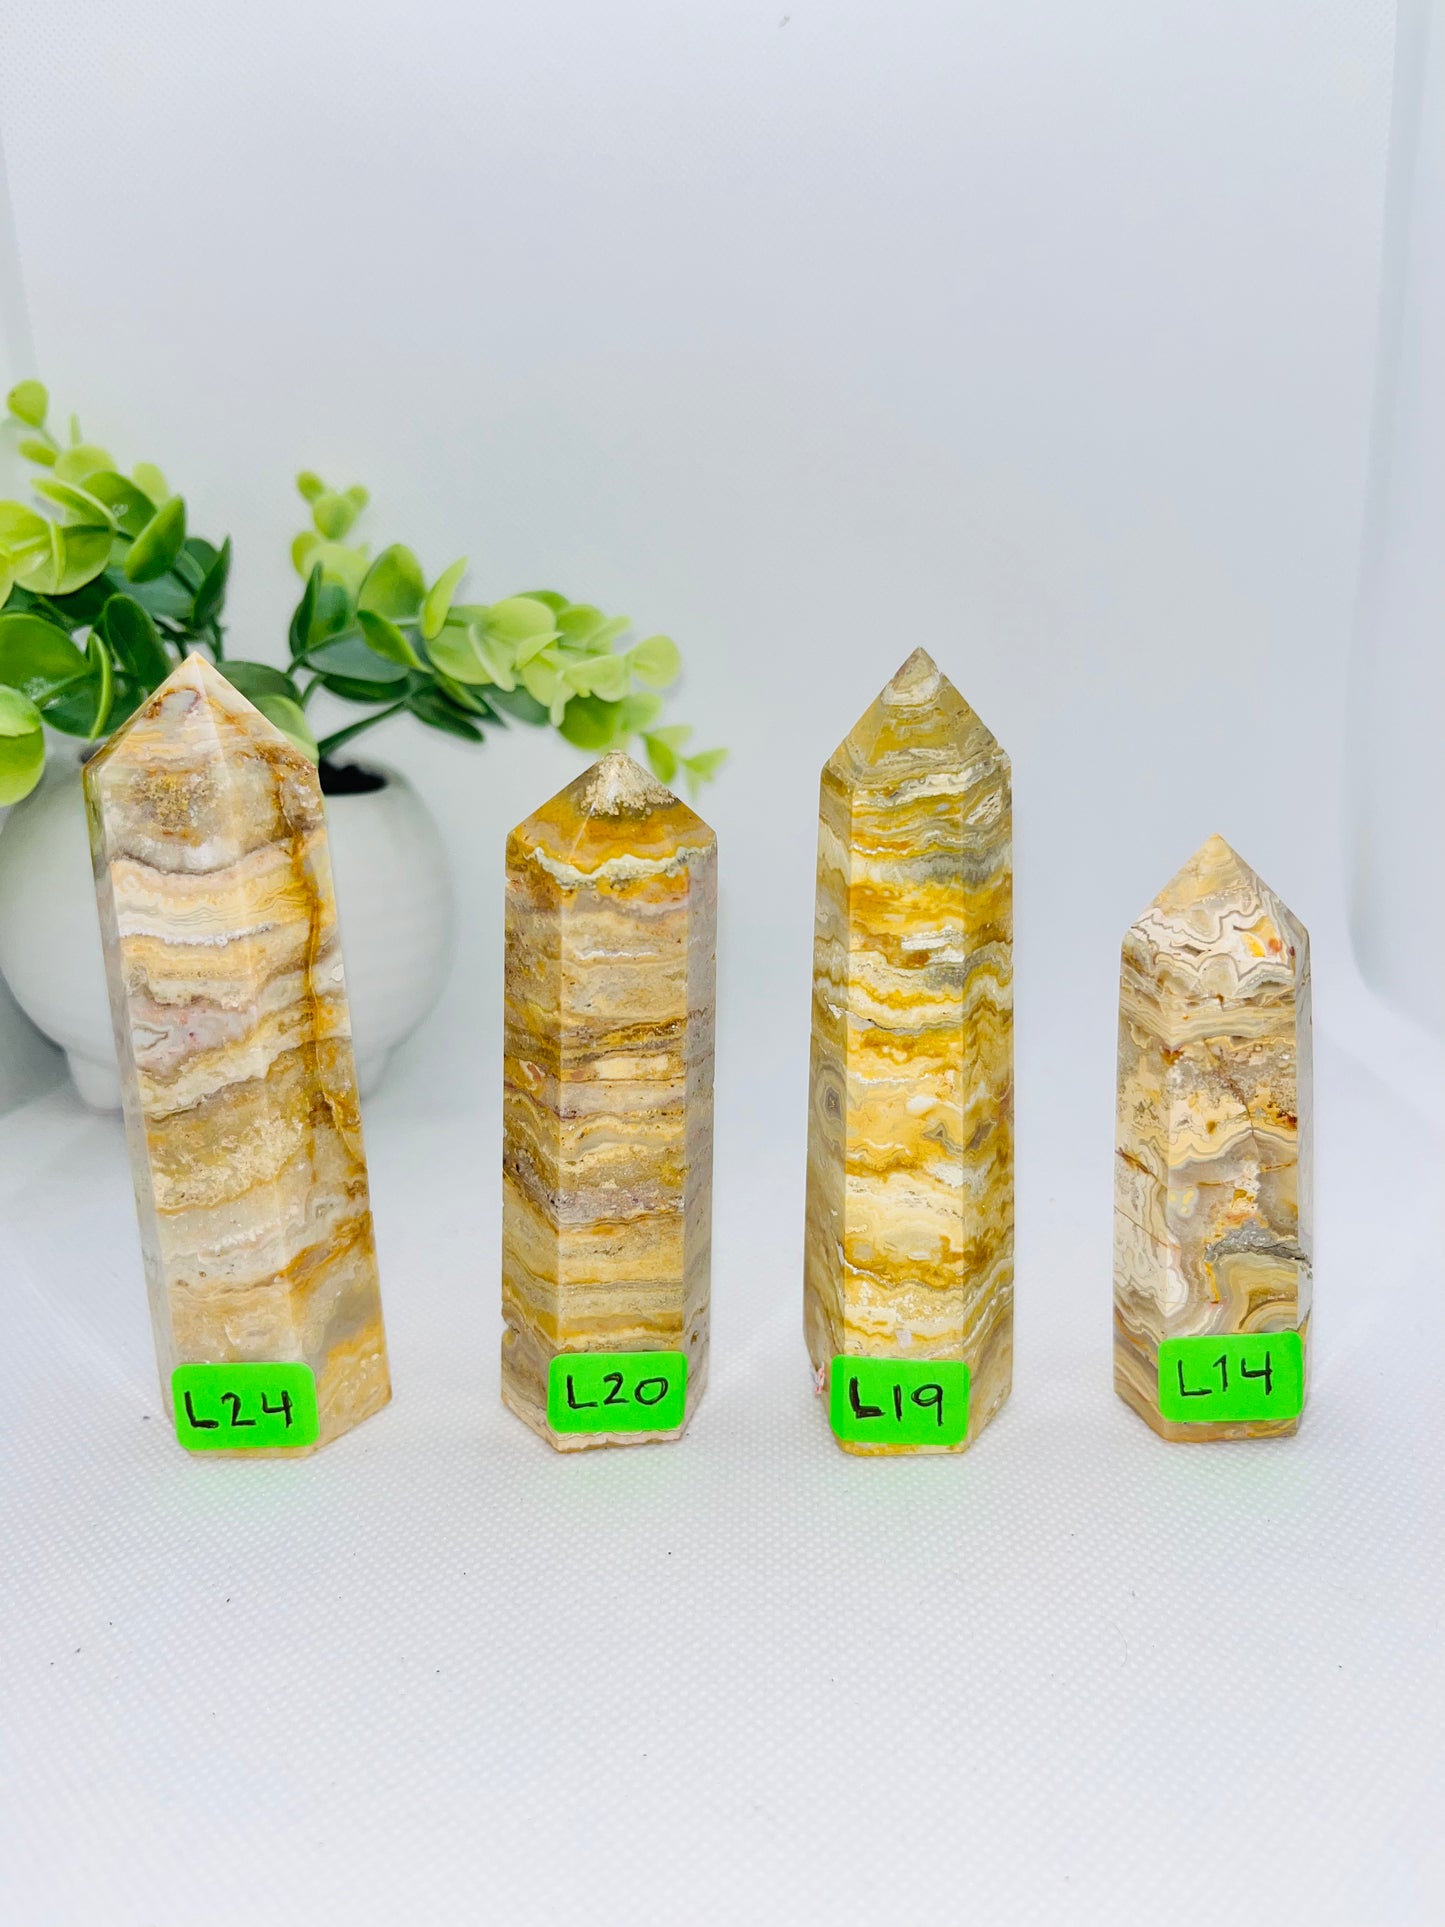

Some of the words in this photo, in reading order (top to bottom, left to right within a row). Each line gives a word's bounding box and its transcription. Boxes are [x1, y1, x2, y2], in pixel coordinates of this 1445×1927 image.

[566, 1372, 670, 1410] L20
[1177, 1352, 1274, 1397] L14
[184, 1390, 294, 1429] L24
[848, 1377, 945, 1427] L19
